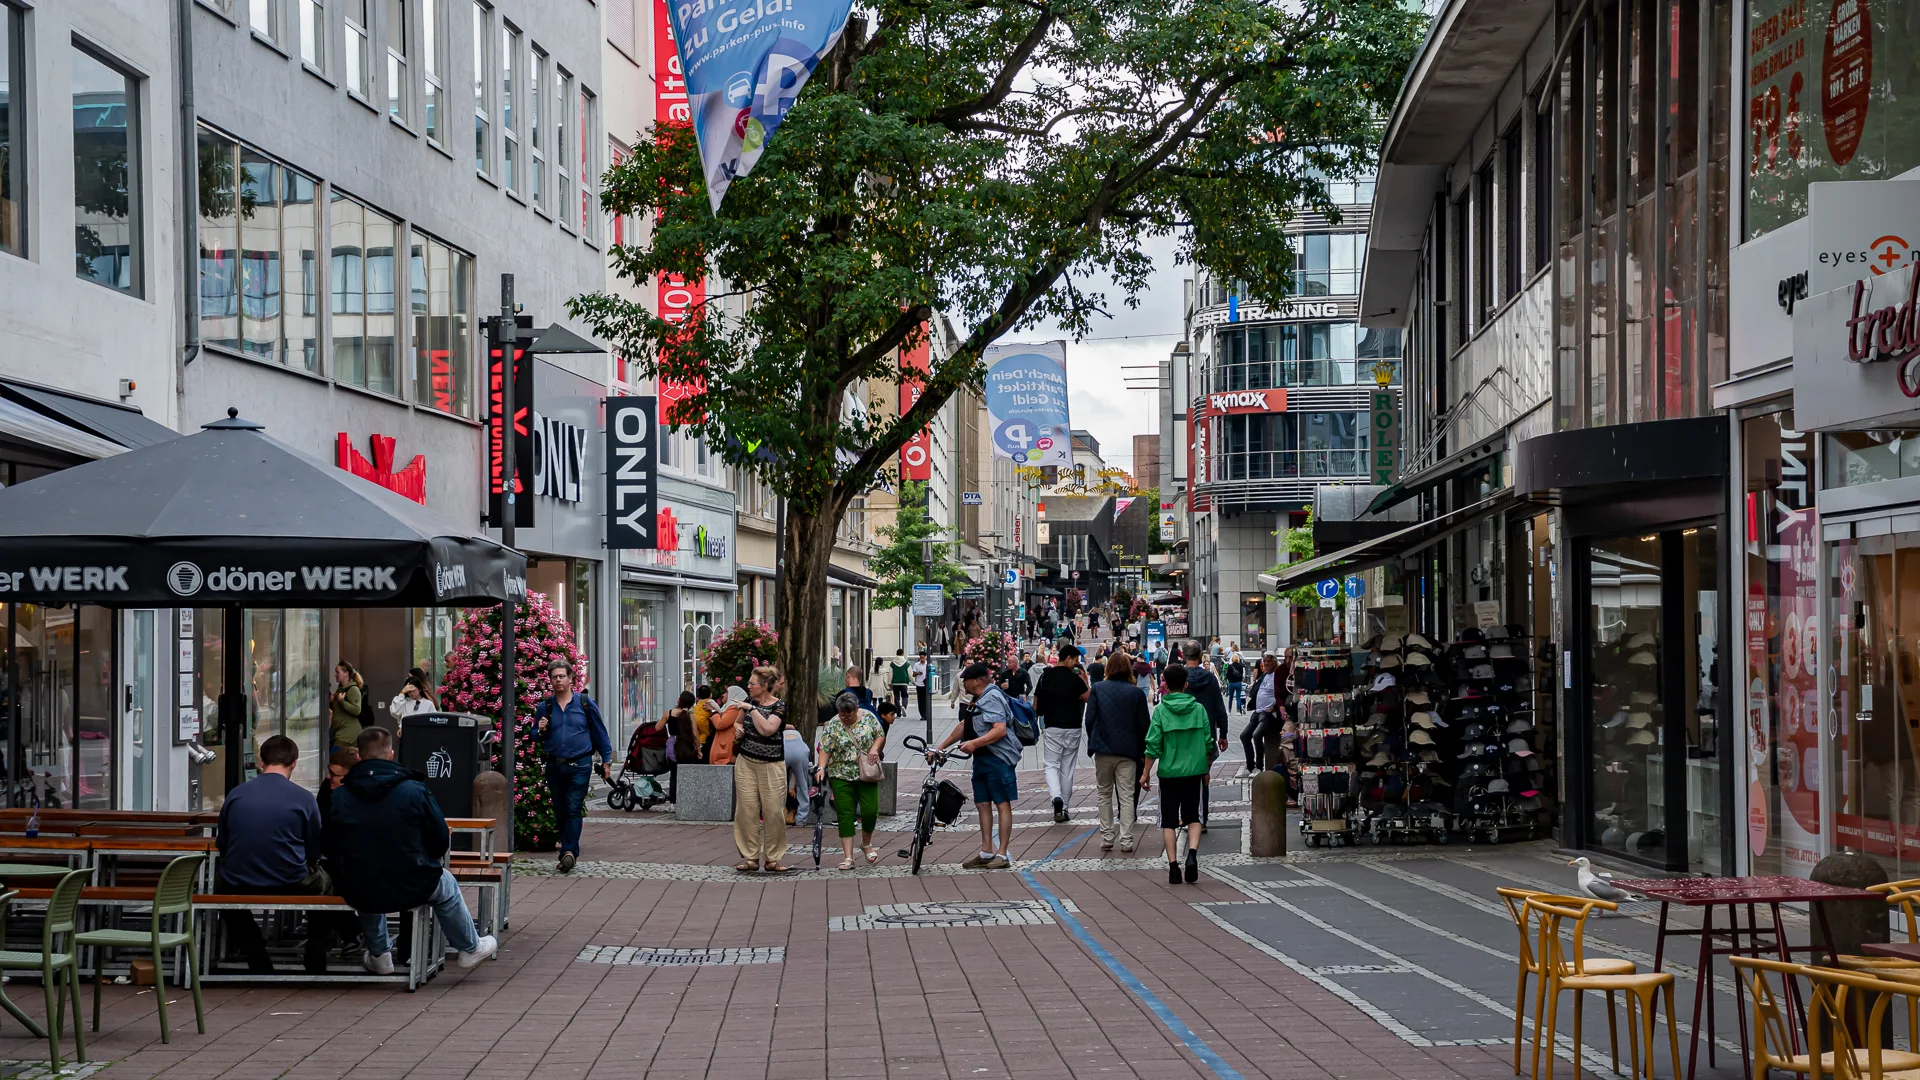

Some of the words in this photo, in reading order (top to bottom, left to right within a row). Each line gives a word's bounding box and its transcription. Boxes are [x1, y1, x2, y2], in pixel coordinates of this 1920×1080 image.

[684, 26, 708, 60] zu
[688, 18, 806, 77] www.parken-plus.info
[1834, 14, 1861, 46] MARKEN
[1819, 251, 1867, 267] eyes
[1846, 260, 1920, 398] tred
[534, 411, 588, 503] ONLY
[1375, 394, 1393, 485] ROLEX
[615, 407, 647, 538] ONLY
[29, 566, 129, 592] WERK
[207, 565, 296, 592] döner
[301, 565, 398, 592] WERK
